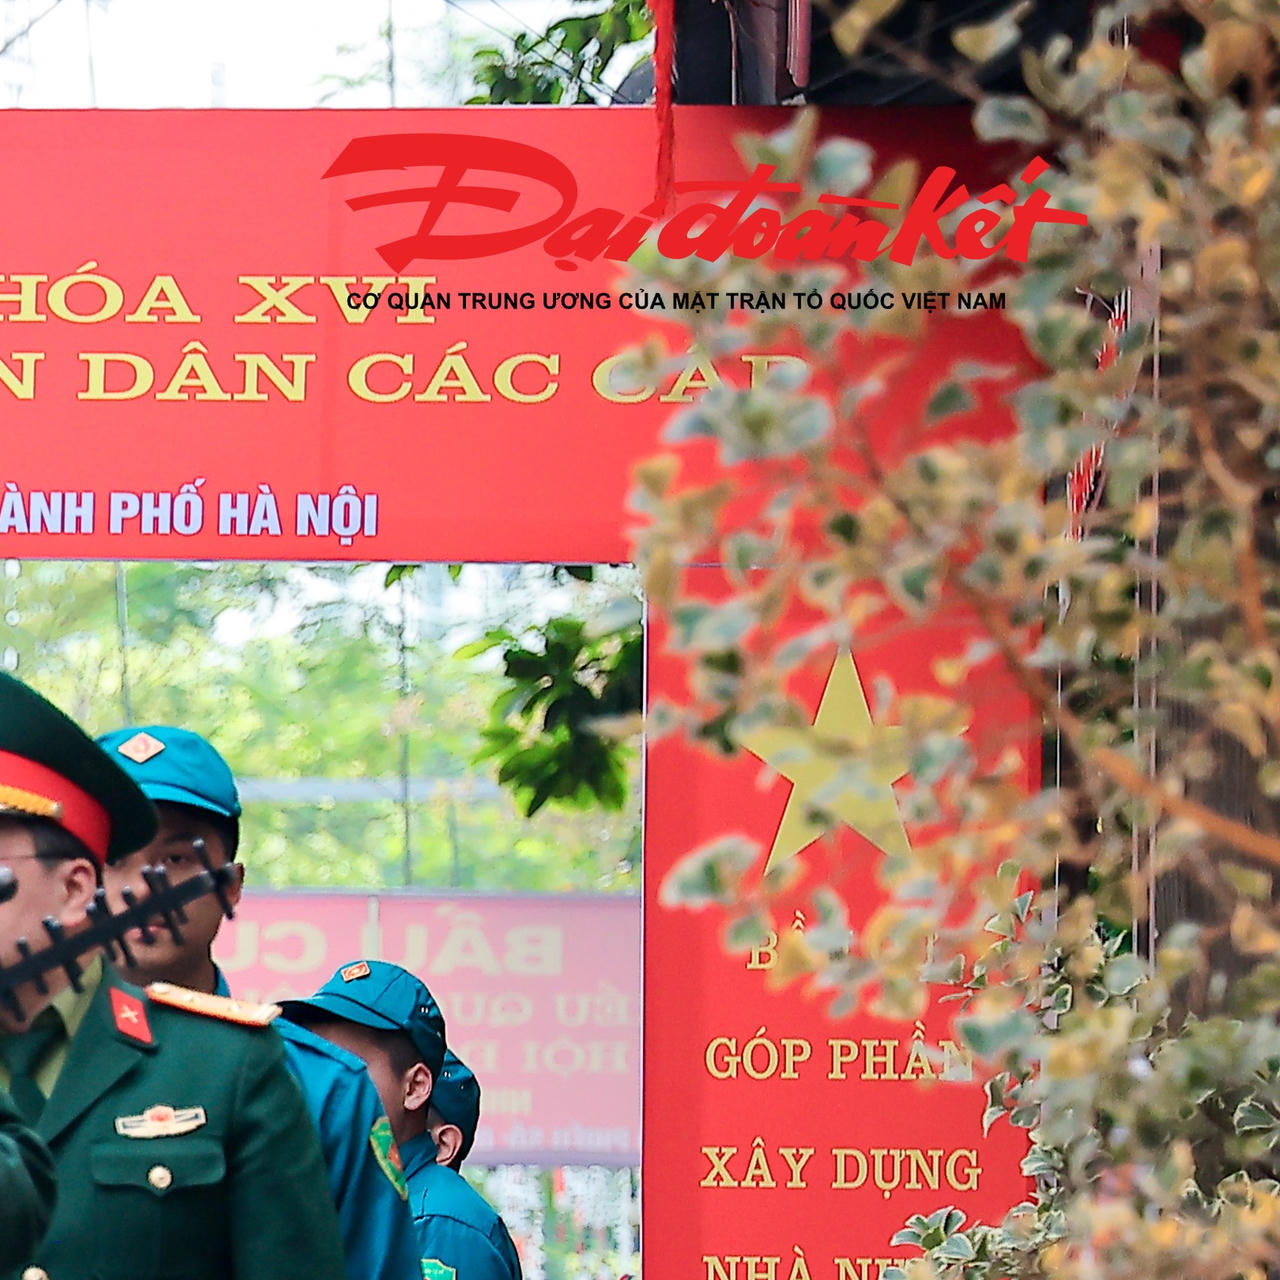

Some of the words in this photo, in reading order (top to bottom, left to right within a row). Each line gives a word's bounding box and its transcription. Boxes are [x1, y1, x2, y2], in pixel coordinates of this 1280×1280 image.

[233, 275, 438, 325] XVI
[76, 340, 317, 402] DÂN
[347, 340, 560, 404] CÁC
[108, 477, 206, 536] PHỐ
[218, 483, 282, 536] HÀ
[295, 484, 378, 547] NỘI
[705, 1026, 812, 1080] GÓP
[699, 1136, 816, 1189] XÂY
[830, 1147, 983, 1200] DỰNG
